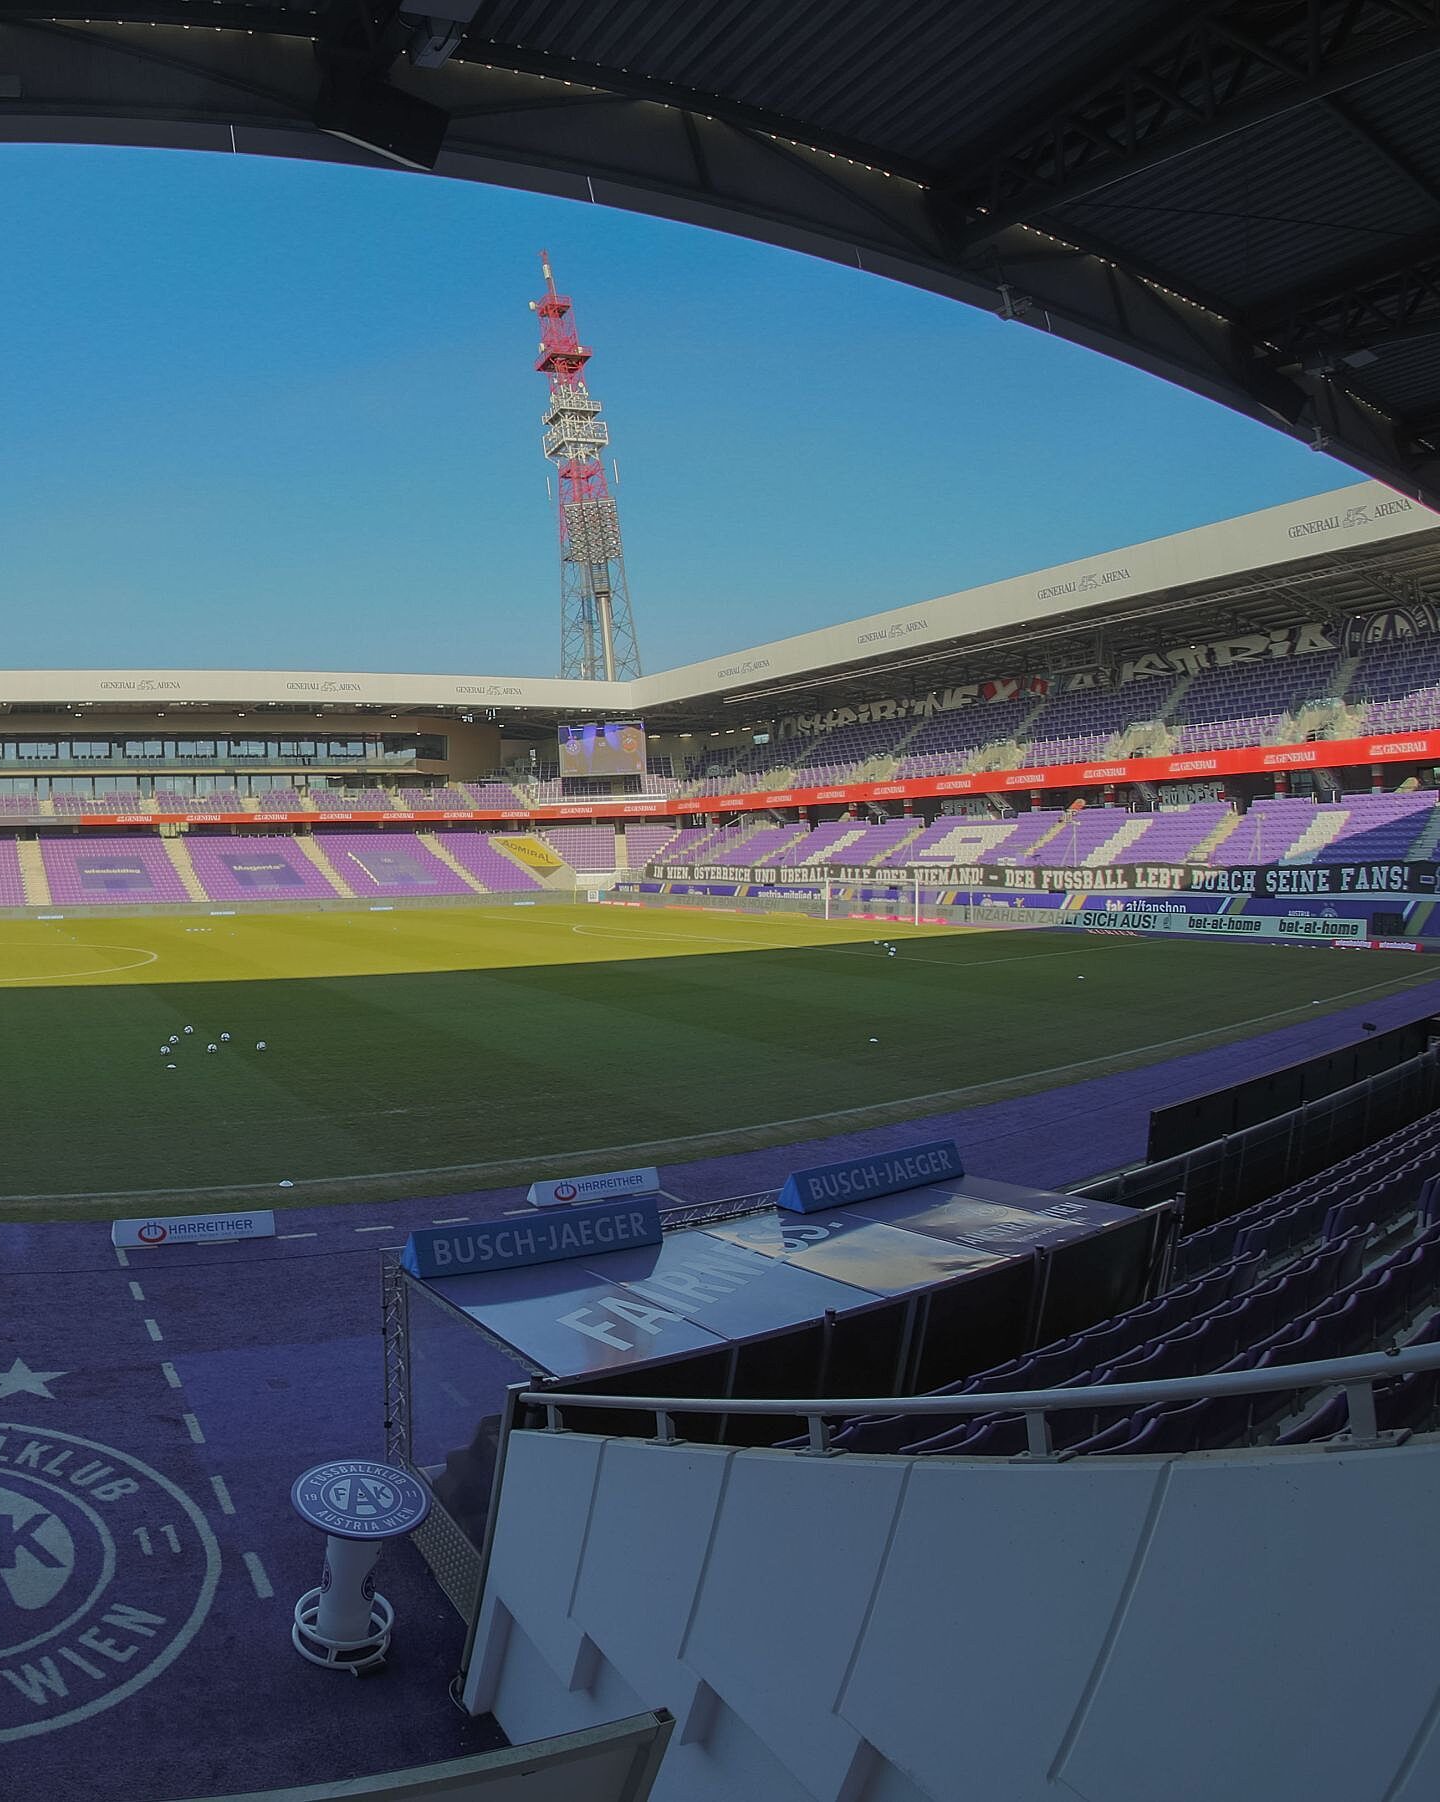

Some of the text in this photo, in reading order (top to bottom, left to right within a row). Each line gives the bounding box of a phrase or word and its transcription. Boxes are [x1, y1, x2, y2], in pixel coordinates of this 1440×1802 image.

[1288, 498, 1412, 538] GENERALI ARENA
[1037, 569, 1131, 600] GENERALI ARENA
[857, 619, 928, 644] GENERALI ARENA
[717, 667, 740, 678] GENERALI
[100, 680, 181, 689] GENERALI ARENA
[286, 682, 360, 691] GENERALI ARENA
[456, 686, 522, 695] GENERALI ARENA
[1382, 741, 1427, 755] GENERALI
[1180, 760, 1216, 771] GENERALI
[1276, 752, 1316, 764] GENERALI
[1015, 774, 1045, 784] GENERALI
[1093, 767, 1126, 777] GENERALI
[880, 786, 905, 794] GENERALI
[944, 780, 971, 789] GENERALI
[501, 839, 553, 864] ADMIRAL
[654, 866, 663, 877] IN
[694, 864, 750, 881] ÖSTERREICH
[755, 868, 776, 883] UND
[840, 868, 870, 880] ALLE
[913, 867, 984, 885] NIEMAND!
[1005, 869, 1035, 888] DER
[1041, 869, 1128, 889] FUSSBALL
[1135, 868, 1184, 889] LEBT
[1191, 869, 1256, 892] DURCH
[1266, 869, 1330, 892] SEINE
[1341, 866, 1409, 890] FANS!
[964, 907, 1034, 924] EINZAHLEN
[1038, 911, 1080, 926] ZAHLT
[1083, 912, 1118, 928] SICH
[1121, 912, 1158, 930] AUS!
[1188, 916, 1262, 931] bet-at-home
[1278, 918, 1359, 936] bet-at-home
[807, 1149, 953, 1200] BUSCH-JAEGER
[577, 1174, 644, 1193] HARREITHER
[168, 1218, 254, 1235] HARREITHER
[431, 1212, 648, 1267] BUSCH-JAEGER
[555, 1217, 843, 1352] FAIRNESS.
[310, 1465, 407, 1486] FUSSBALLKLUB
[305, 1493, 318, 1501] 19
[406, 1490, 417, 1498] 11
[316, 1507, 415, 1531] AUSTRIA WIEN
[132, 1524, 182, 1555] 11
